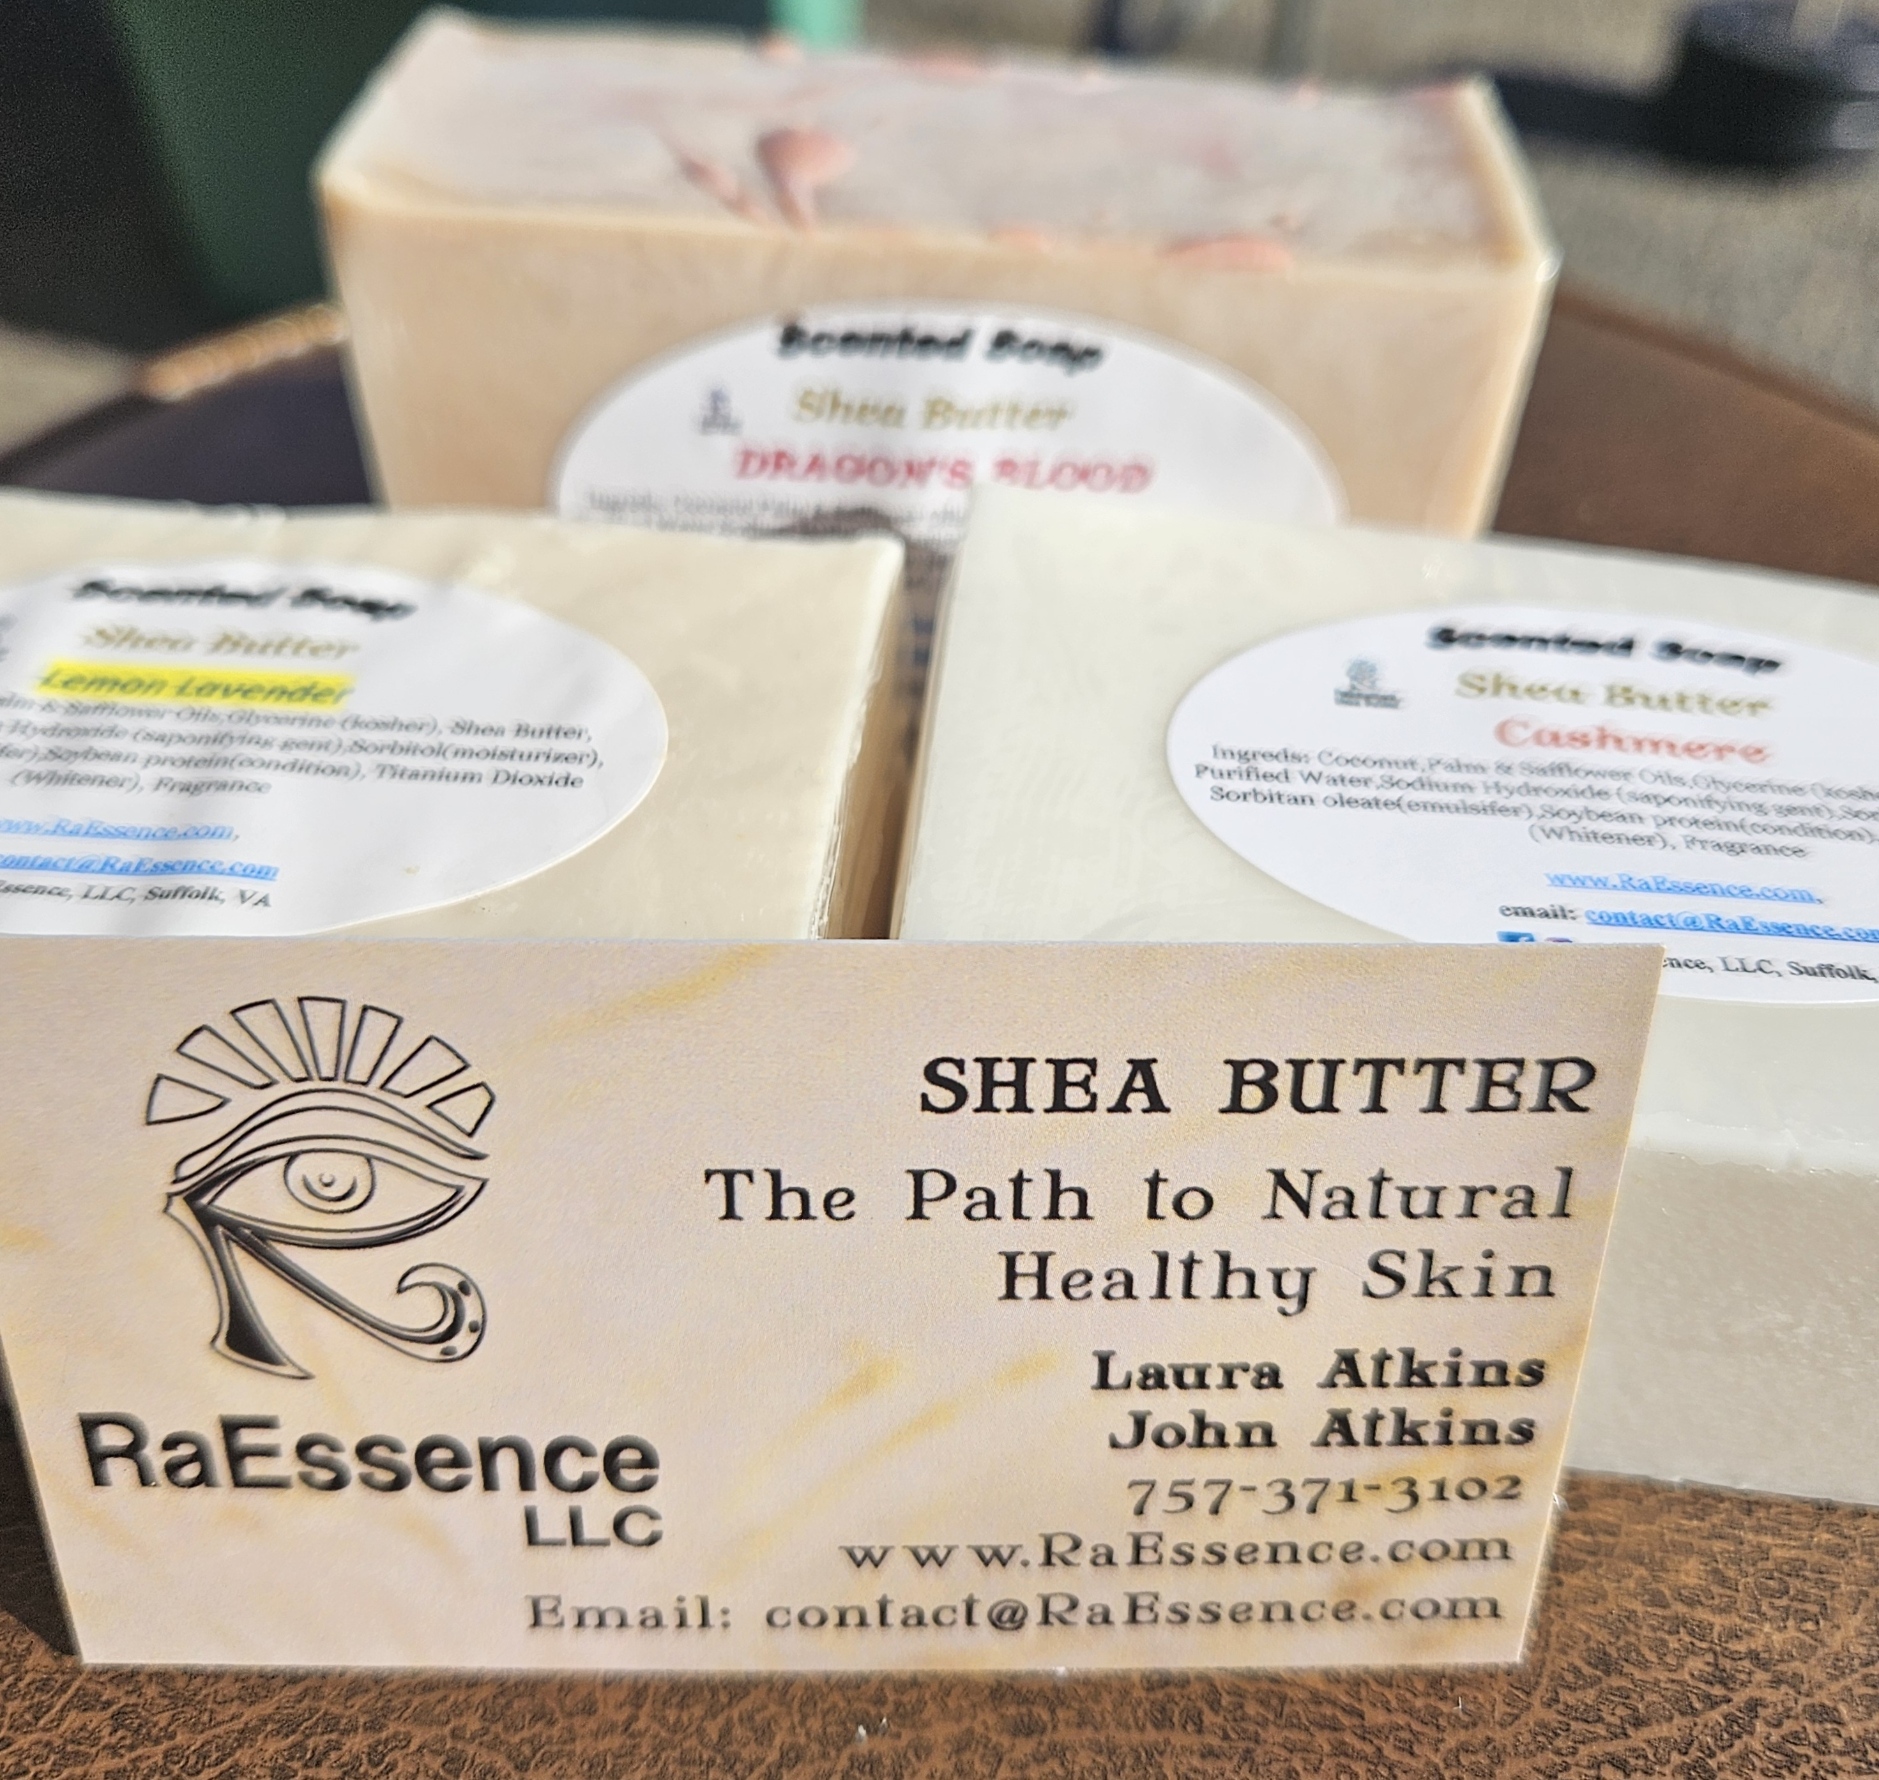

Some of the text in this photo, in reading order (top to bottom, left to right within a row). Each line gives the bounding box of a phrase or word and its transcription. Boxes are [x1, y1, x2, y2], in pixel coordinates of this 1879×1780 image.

[776, 321, 1105, 375] Scented Soap
[792, 388, 909, 430] Shea
[918, 395, 1073, 435] Butter
[83, 624, 358, 660] Shea Butter
[40, 666, 356, 706] Lemon Lavender
[1455, 670, 1772, 718] Shea Butter
[450, 719, 506, 738] Shea
[511, 722, 593, 743] Butter,
[1493, 716, 1770, 765] Cashmere
[374, 763, 483, 785] Titanium
[491, 769, 584, 789] Dioxide
[1195, 764, 1291, 785] Purified
[1212, 744, 1311, 765] Ingreds:
[11, 769, 272, 796] (Whitener), Fragrance
[1209, 785, 1314, 807] Sorbitan
[1528, 821, 1807, 858] (Whitener), Fragrance
[81, 884, 136, 904] LLC,
[143, 886, 226, 906] Suffolk,
[239, 889, 272, 907] VA
[1544, 871, 1823, 906] www.RaEssence.com,
[1499, 903, 1575, 922] email:
[1717, 955, 1782, 977] LLC,
[1786, 960, 1879, 984] Suffolk,
[919, 1055, 1598, 1115] SHEA BUTTER
[704, 1165, 1577, 1222] The Path to Natural
[997, 1247, 1558, 1317] Healthy Skin
[1090, 1347, 1548, 1394] Laura Atkins
[1107, 1408, 1537, 1454] John Atkins
[78, 1410, 662, 1496] RaEssence
[1126, 1474, 1524, 1519] 757-371-3102
[523, 1504, 664, 1548] LLC
[838, 1529, 1515, 1572] www.RaEssence.com
[526, 1590, 1504, 1633] Email: contact@RaEssence.com
